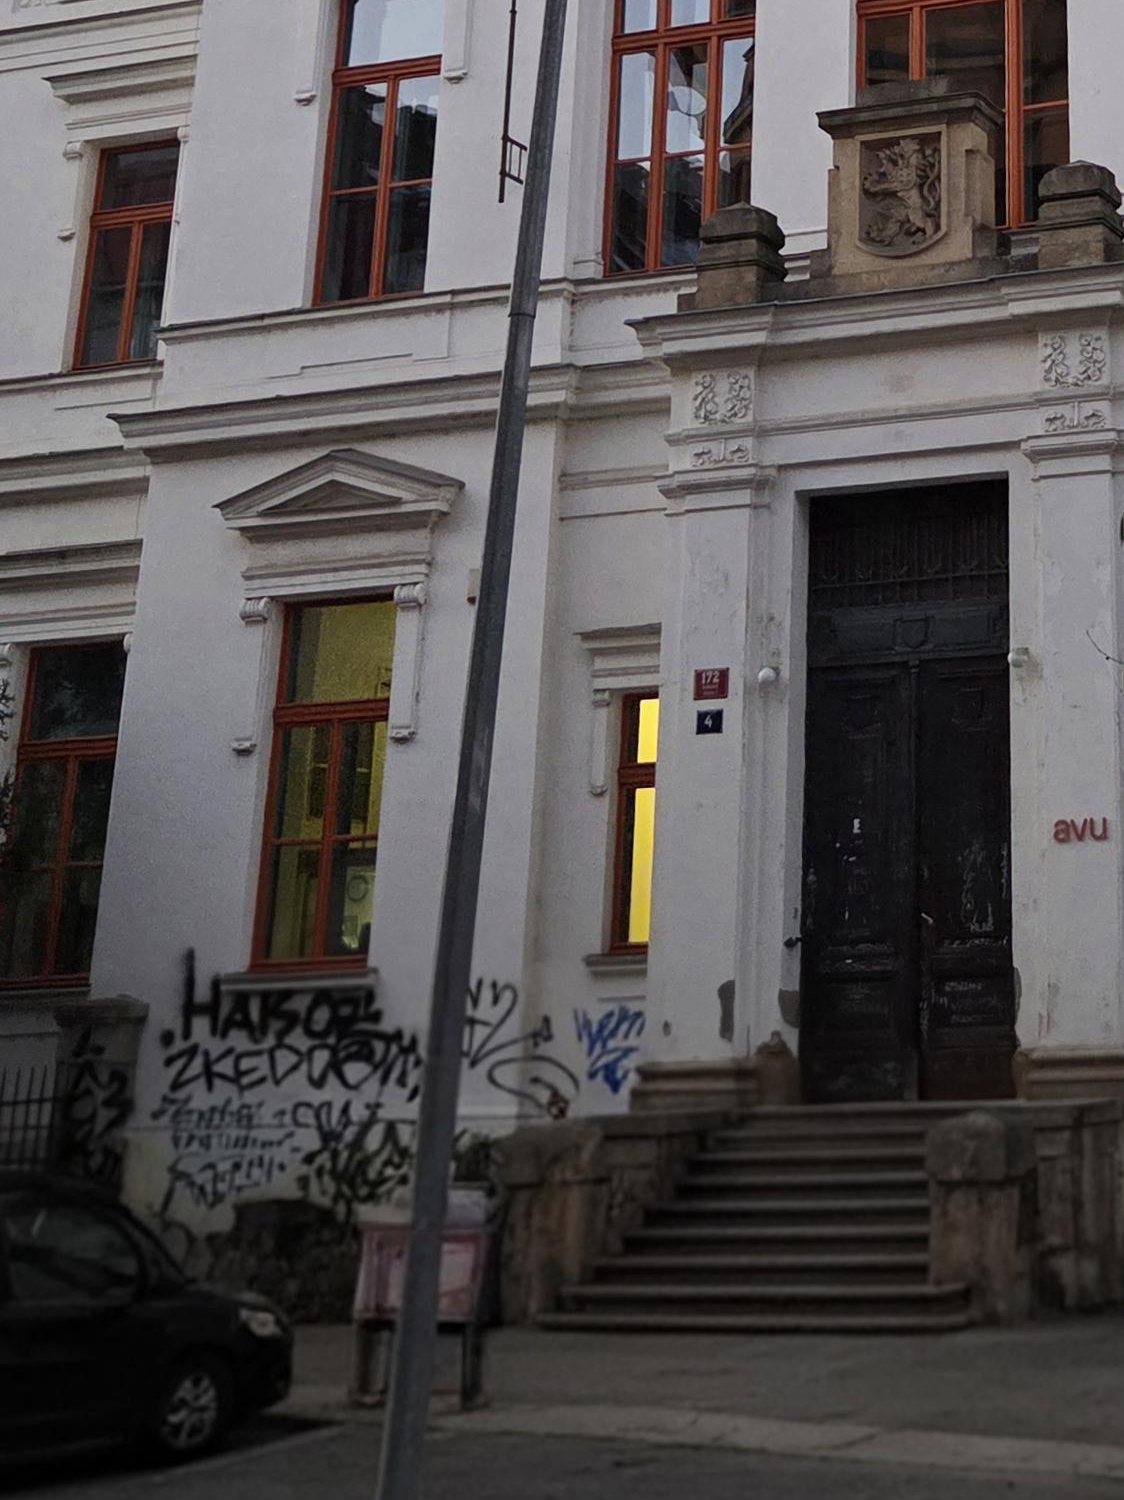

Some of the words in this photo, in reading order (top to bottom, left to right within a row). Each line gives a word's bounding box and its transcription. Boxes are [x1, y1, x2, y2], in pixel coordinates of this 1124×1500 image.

[701, 670, 720, 684] 172
[703, 714, 713, 729] 4
[1053, 816, 1108, 844] avu
